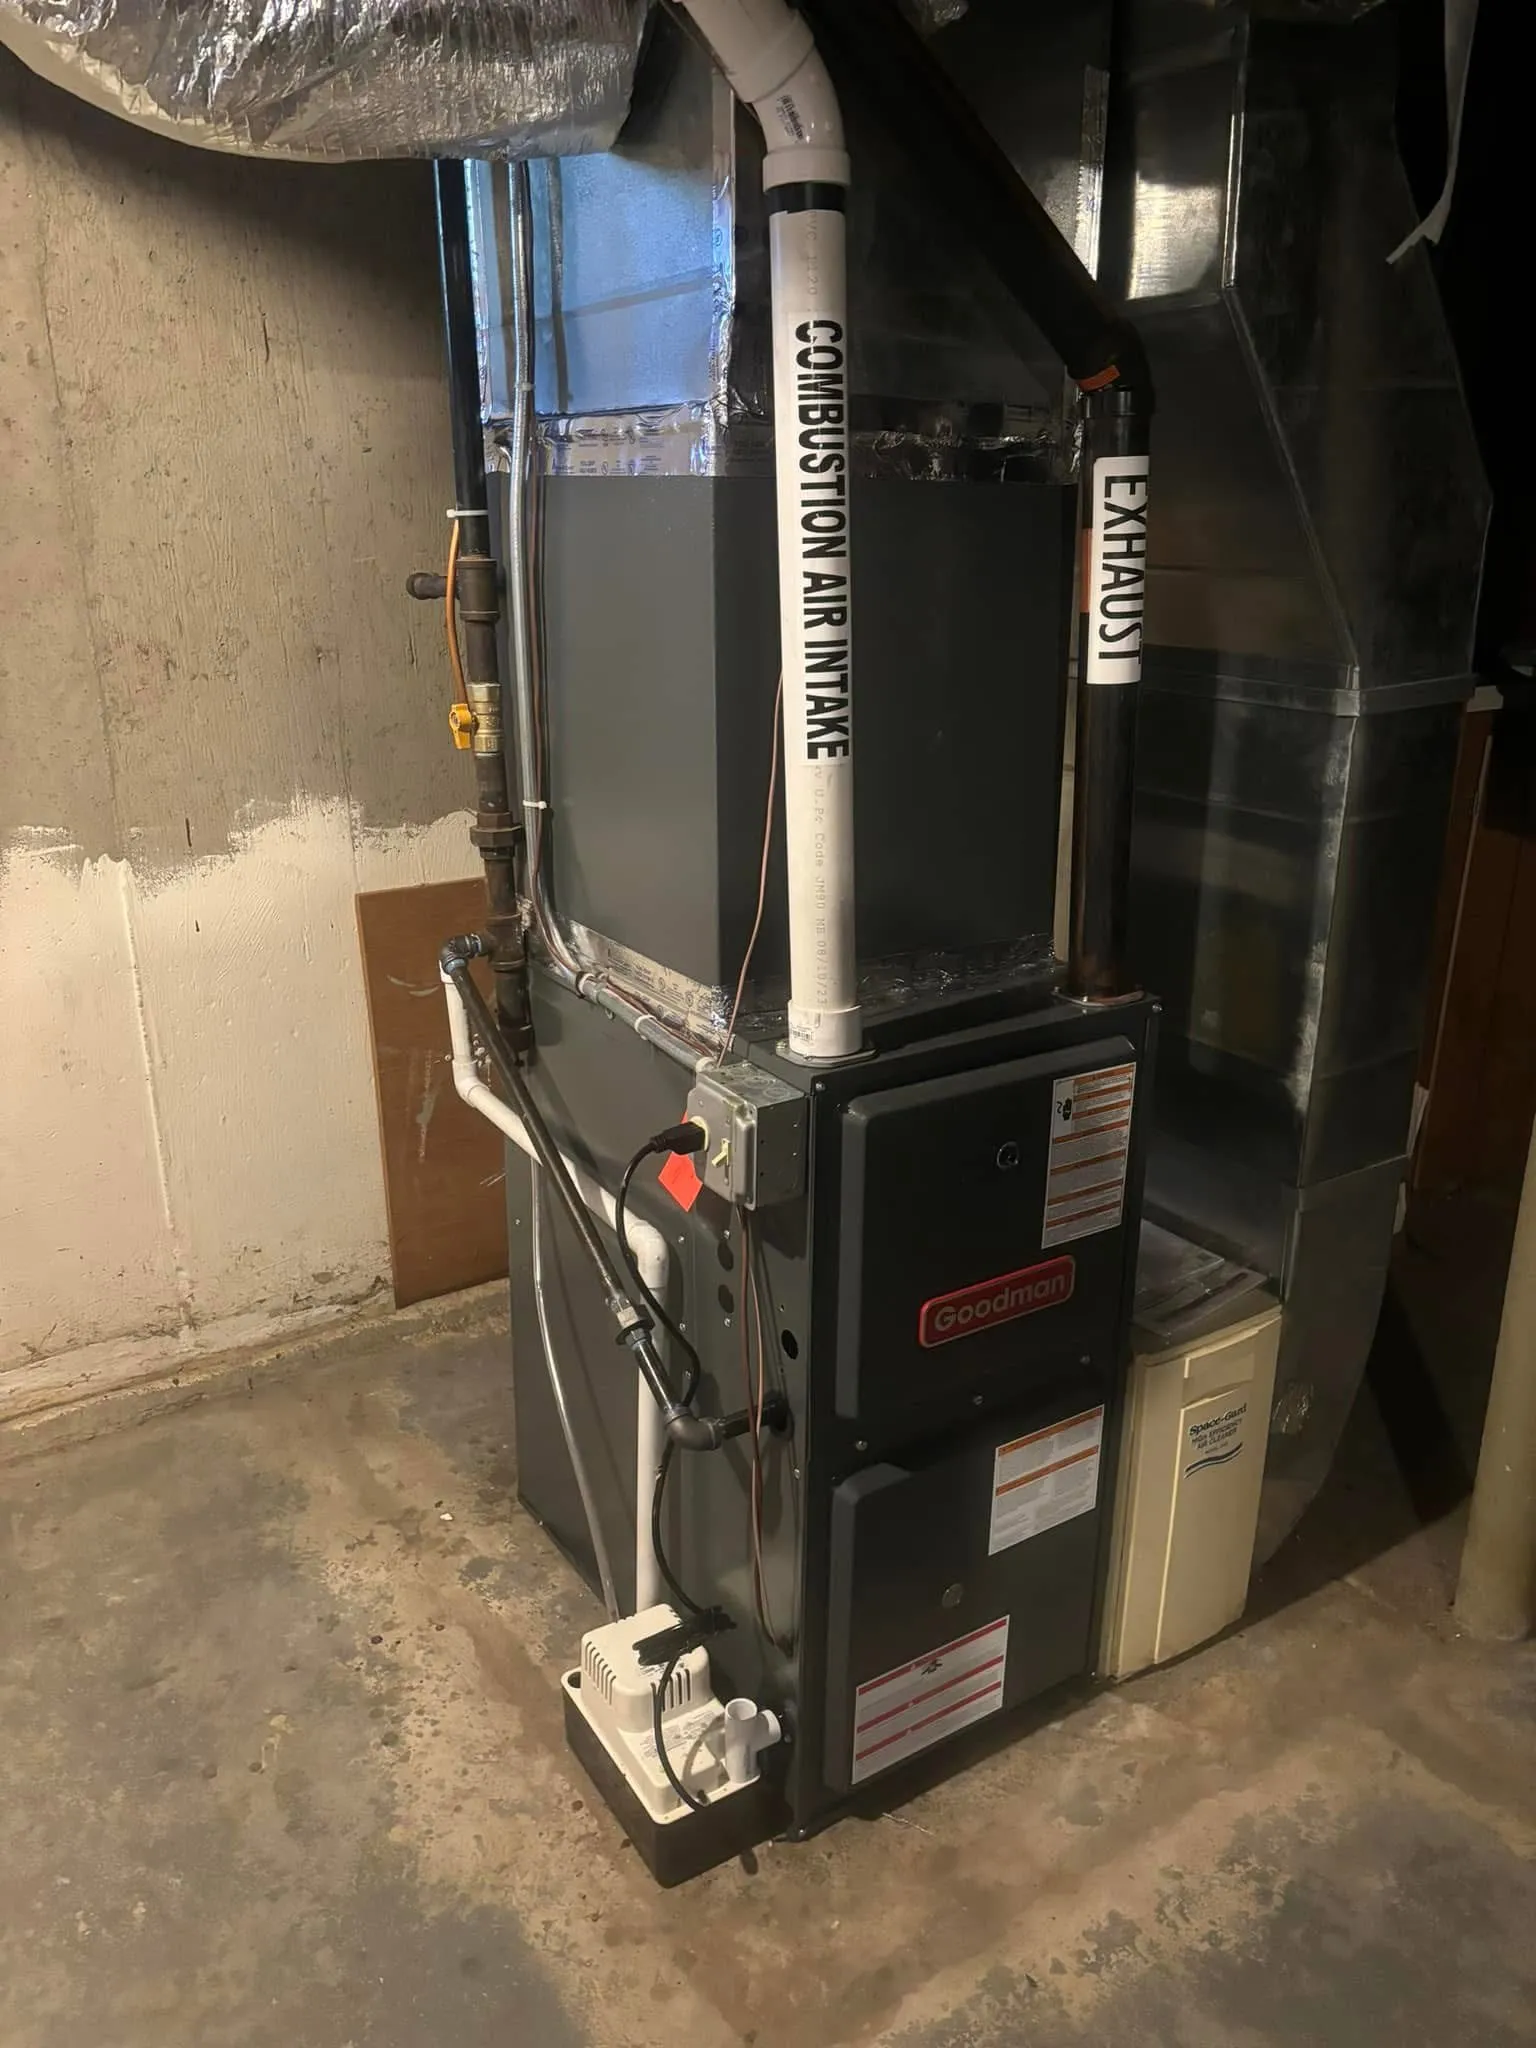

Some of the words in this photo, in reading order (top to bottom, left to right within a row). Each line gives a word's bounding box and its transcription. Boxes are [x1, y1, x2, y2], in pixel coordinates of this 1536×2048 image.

[795, 320, 847, 559] COMBUSTION
[803, 571, 848, 630] AIR
[1098, 475, 1148, 664] EXHAUST
[805, 638, 850, 760] INTAKE
[814, 833, 826, 867] Code
[934, 1274, 1065, 1332] Goodman
